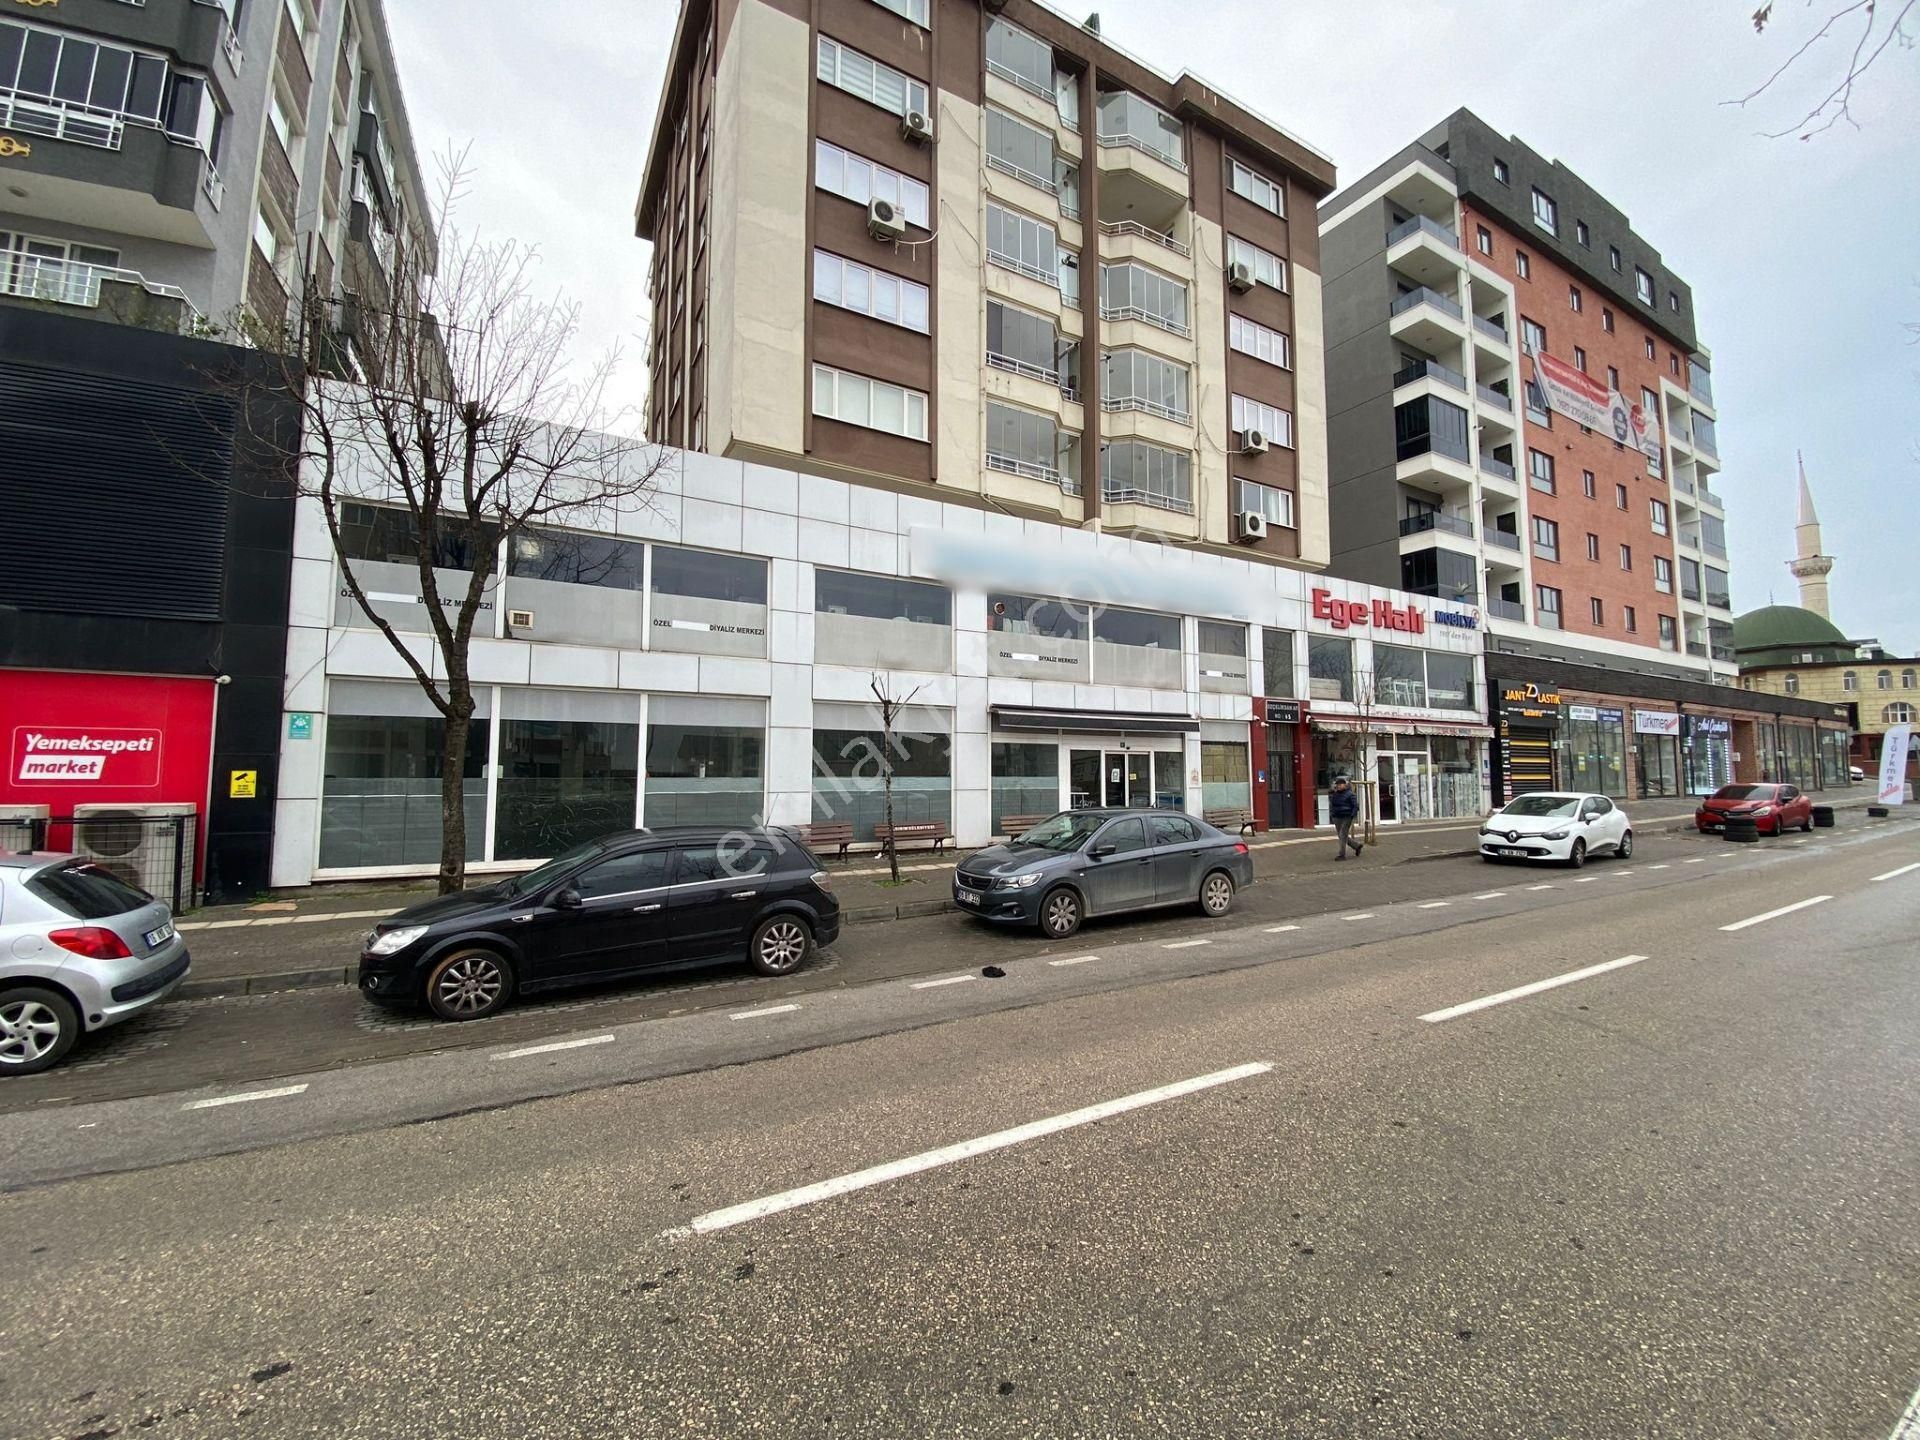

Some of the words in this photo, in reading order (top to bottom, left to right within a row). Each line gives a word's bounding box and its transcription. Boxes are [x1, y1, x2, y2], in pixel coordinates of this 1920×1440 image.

[1312, 588, 1368, 629] Ege
[1372, 599, 1424, 634] Halı
[653, 619, 672, 628] ÖZEL
[736, 626, 765, 636] MERKEZİ
[1504, 689, 1525, 700] JANT
[1537, 693, 1561, 705] LASTİK
[25, 733, 154, 755] Yemeksepeti
[26, 760, 97, 774] market
